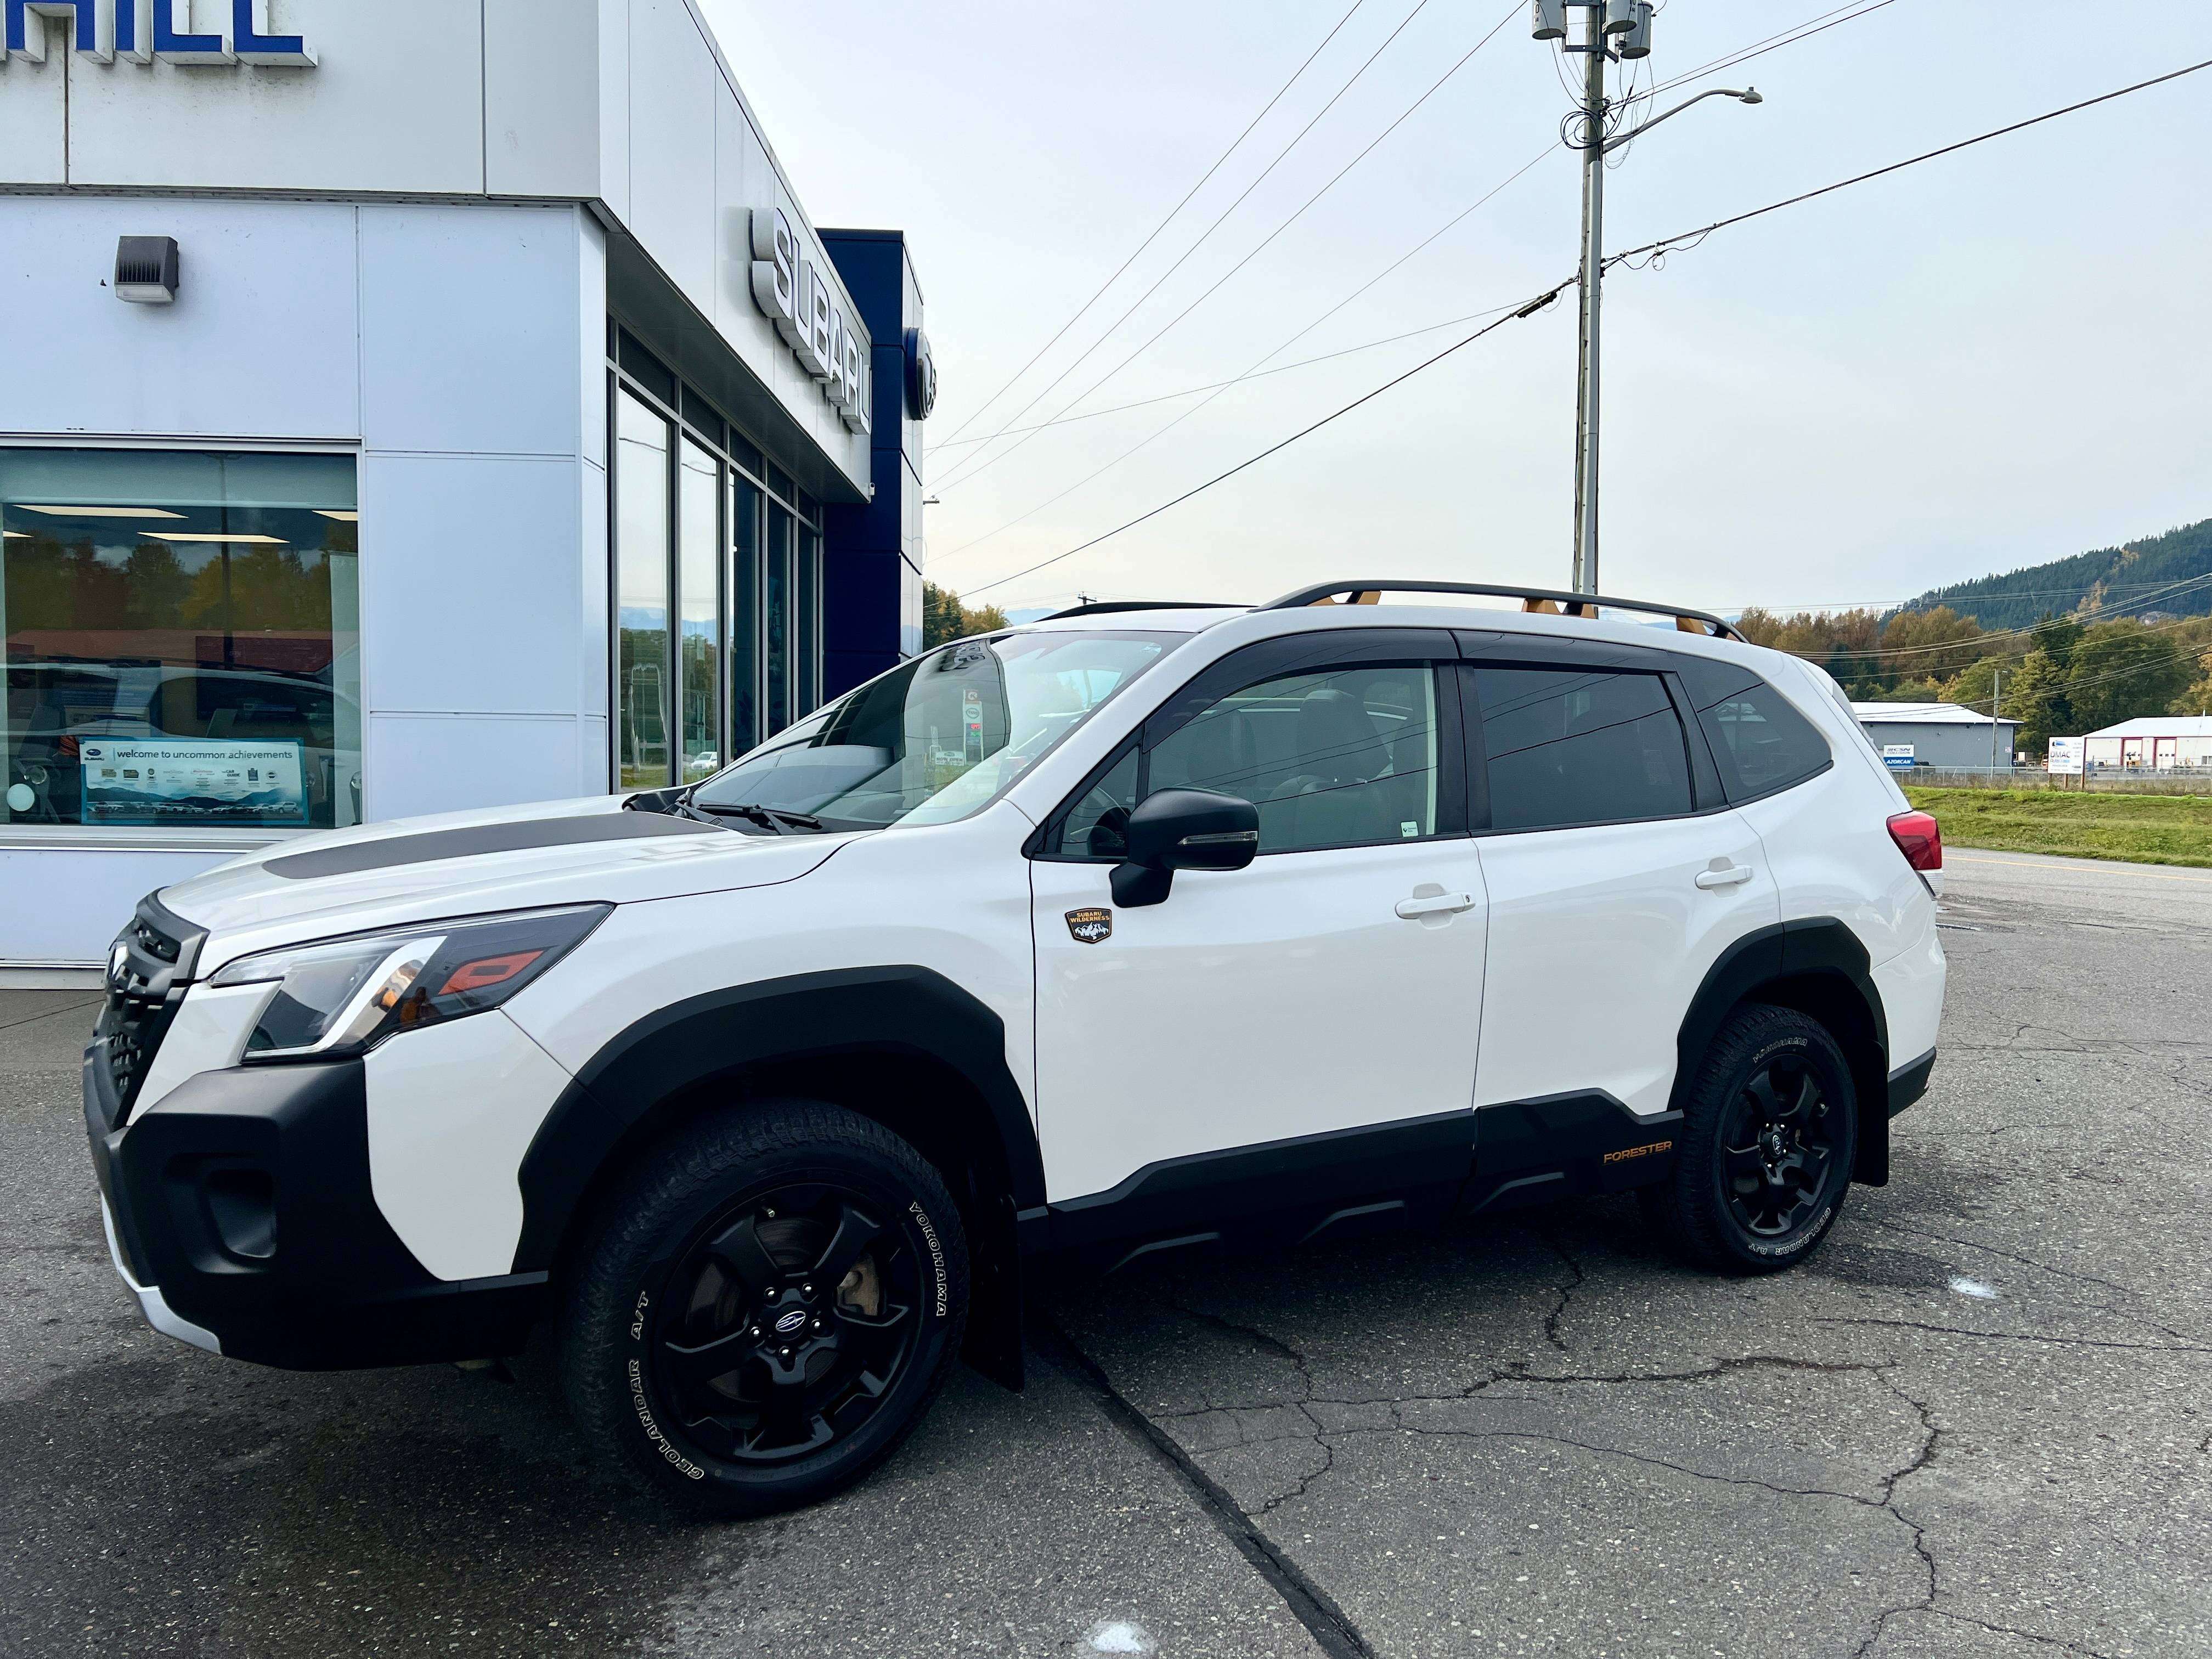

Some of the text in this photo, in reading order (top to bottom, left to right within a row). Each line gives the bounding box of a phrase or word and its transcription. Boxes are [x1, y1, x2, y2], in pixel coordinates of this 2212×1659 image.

[117, 749, 159, 758] welcome
[228, 750, 292, 759] achievements
[1604, 1141, 1672, 1164] FORESTER
[1748, 1207, 1831, 1256] GEOLANDAR A/T
[910, 1202, 946, 1316] YOKOHAMA
[629, 1291, 704, 1479] GEOLANDAR A/T
